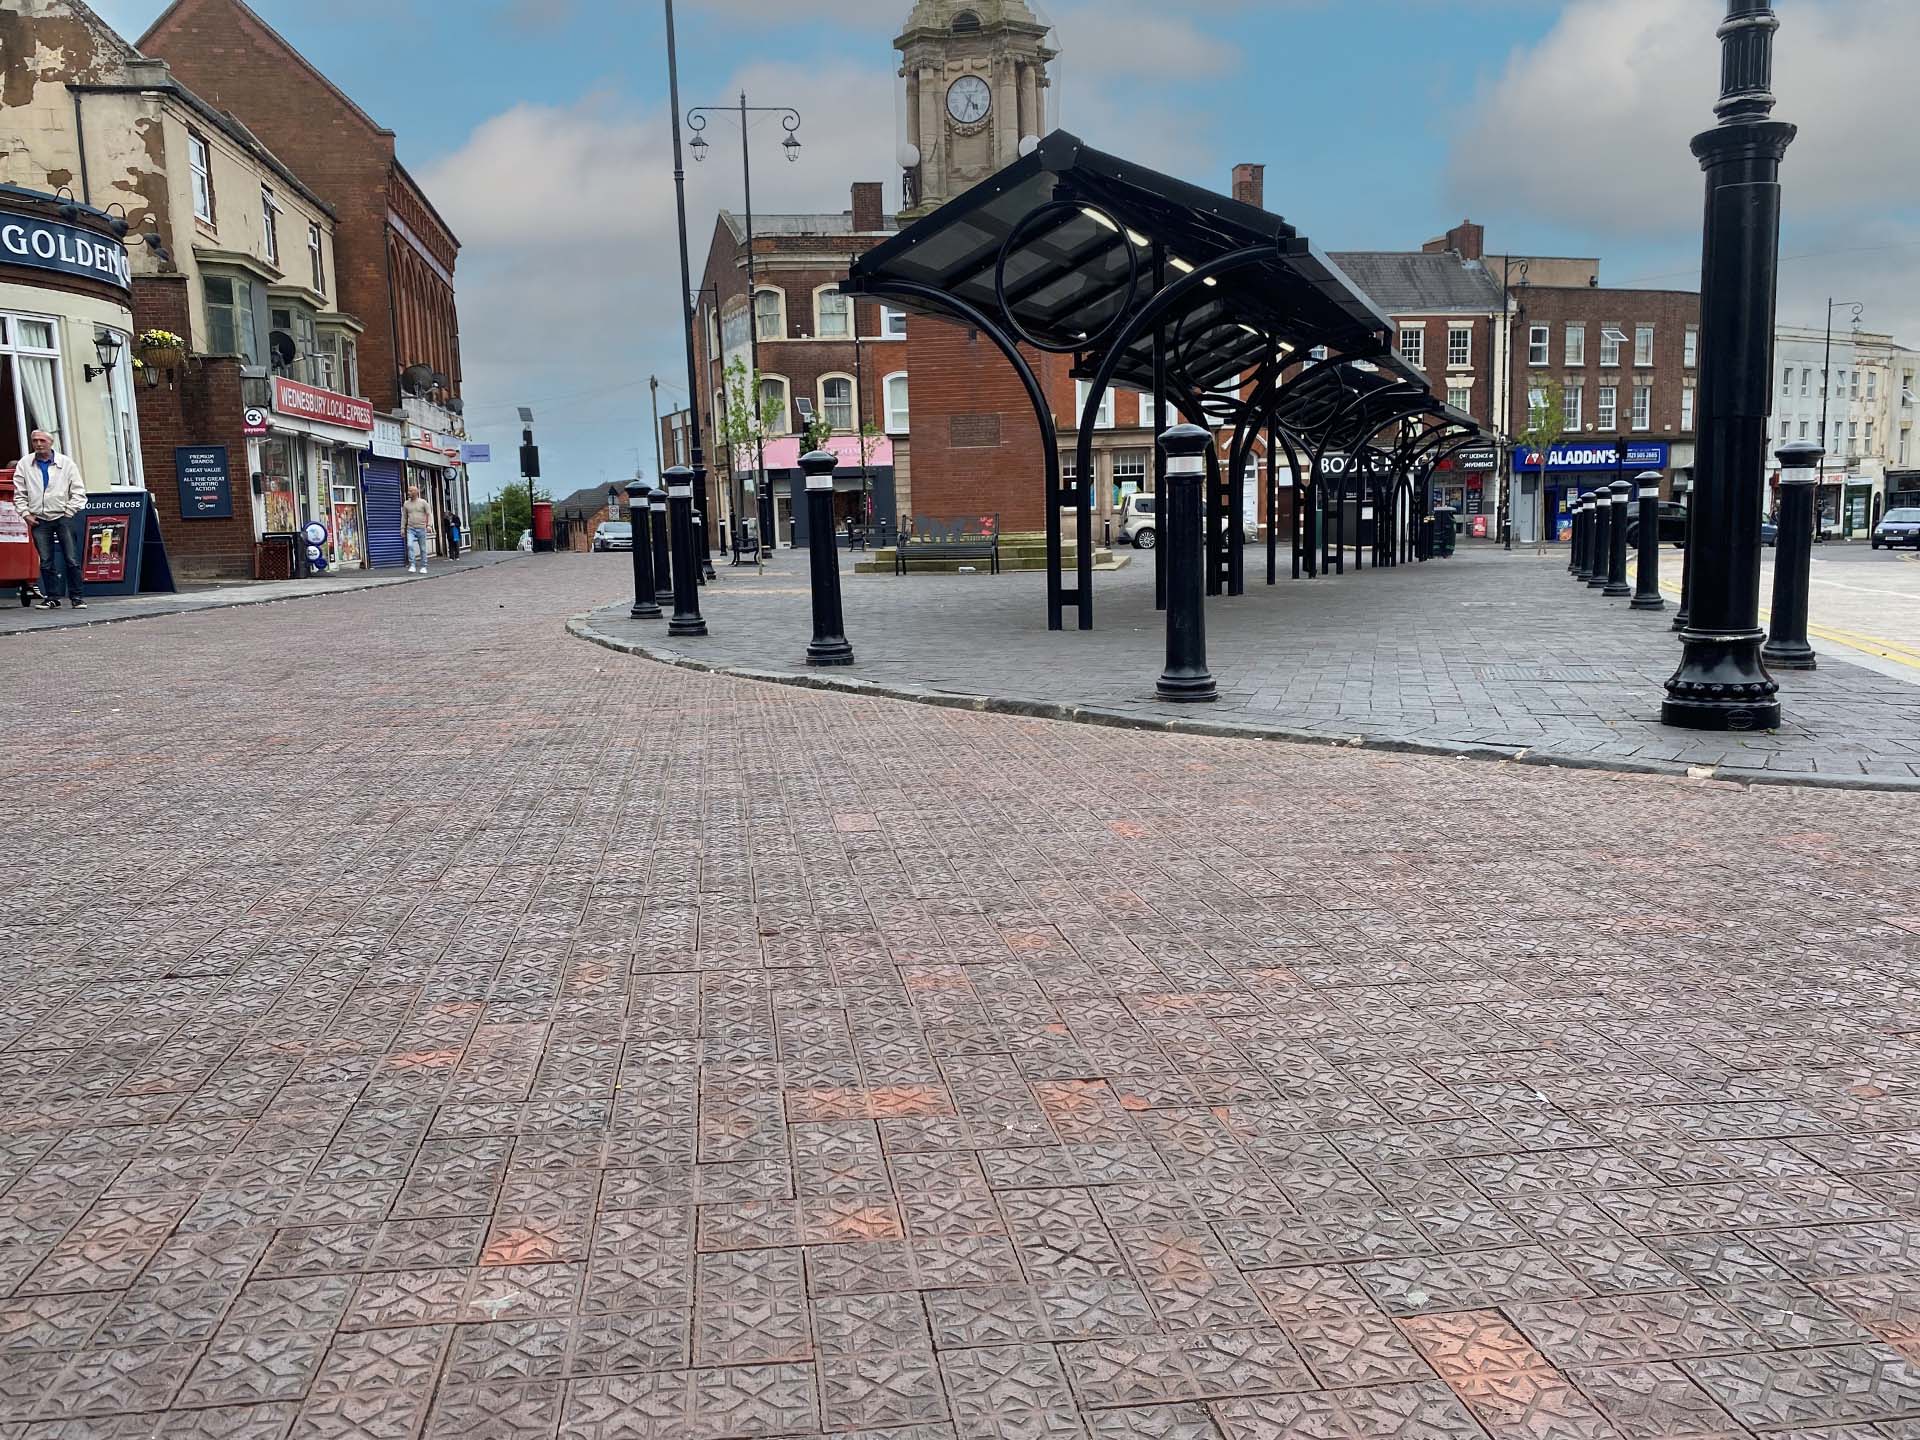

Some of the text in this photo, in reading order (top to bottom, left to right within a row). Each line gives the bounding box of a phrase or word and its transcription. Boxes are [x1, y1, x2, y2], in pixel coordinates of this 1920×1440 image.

[2, 225, 120, 275] GOLDEN
[281, 386, 371, 424] WEDNESBURY LOCAL EXPRESS
[85, 502, 112, 510] OLDEN
